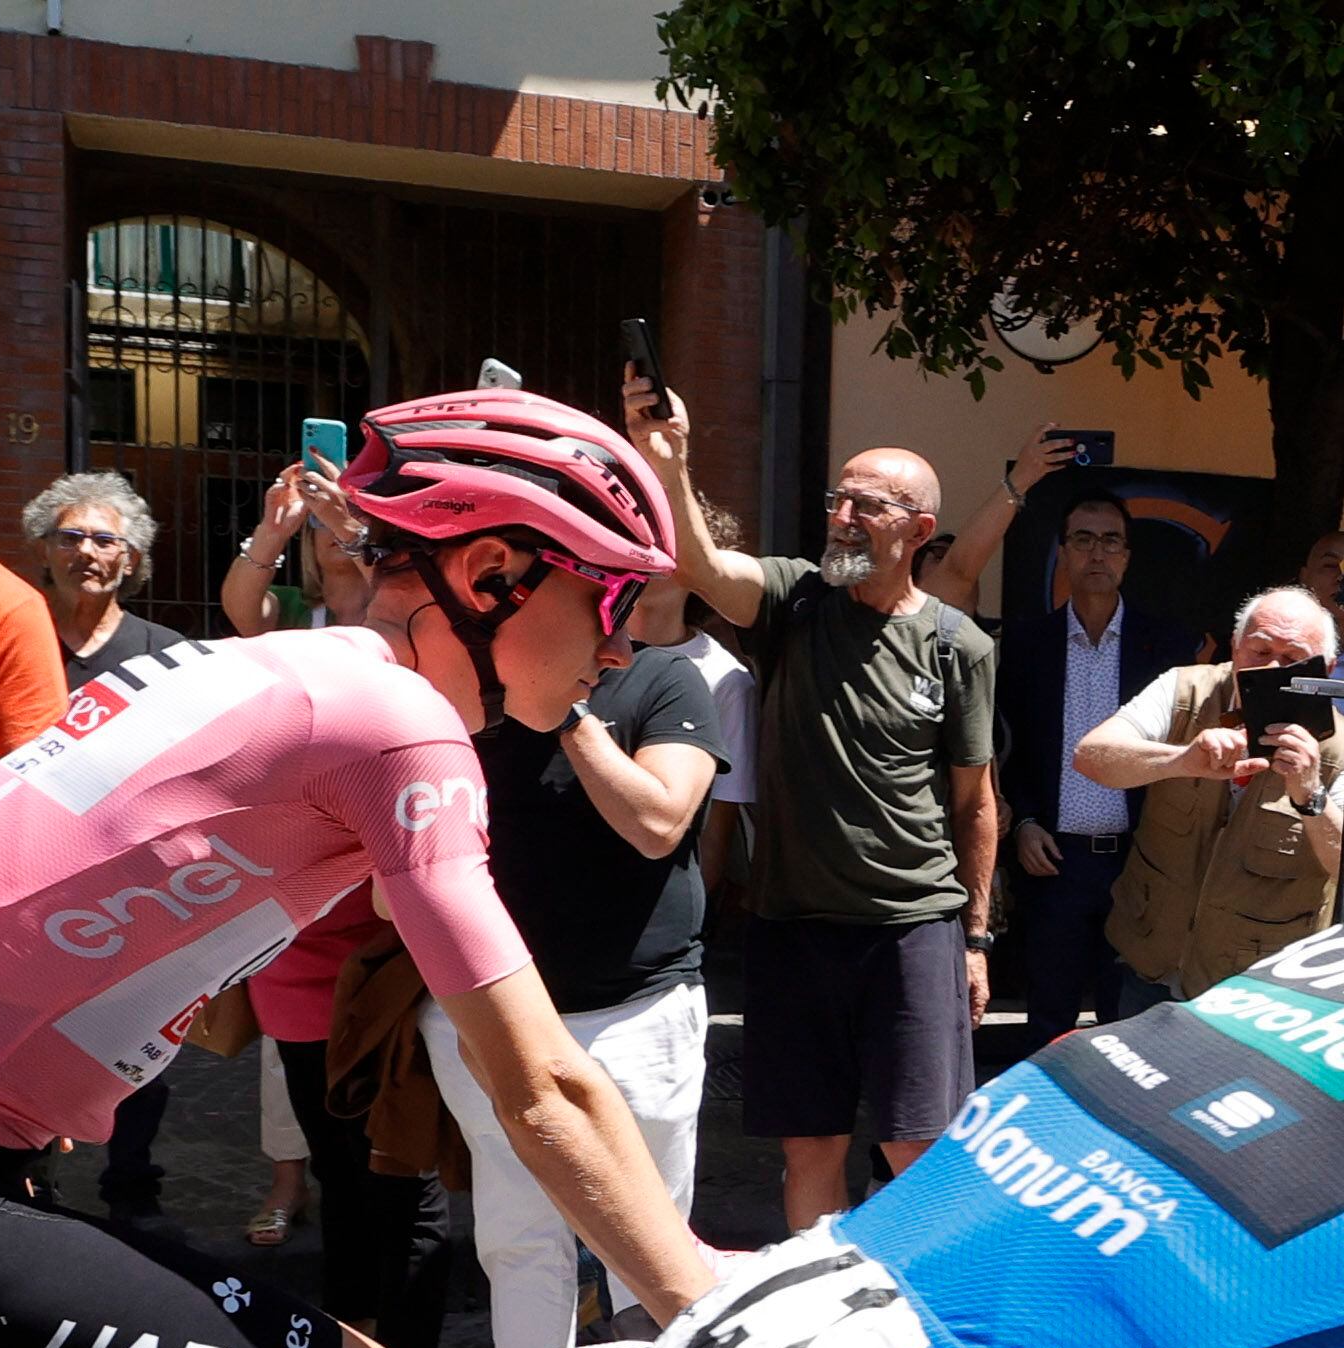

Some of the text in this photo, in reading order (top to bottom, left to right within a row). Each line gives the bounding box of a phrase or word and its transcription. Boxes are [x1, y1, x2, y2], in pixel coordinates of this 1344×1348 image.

[7, 412, 39, 445] 19
[422, 498, 477, 515] presight
[572, 449, 646, 519] MET
[44, 834, 274, 959] enel
[1077, 1149, 1178, 1222] BANCA
